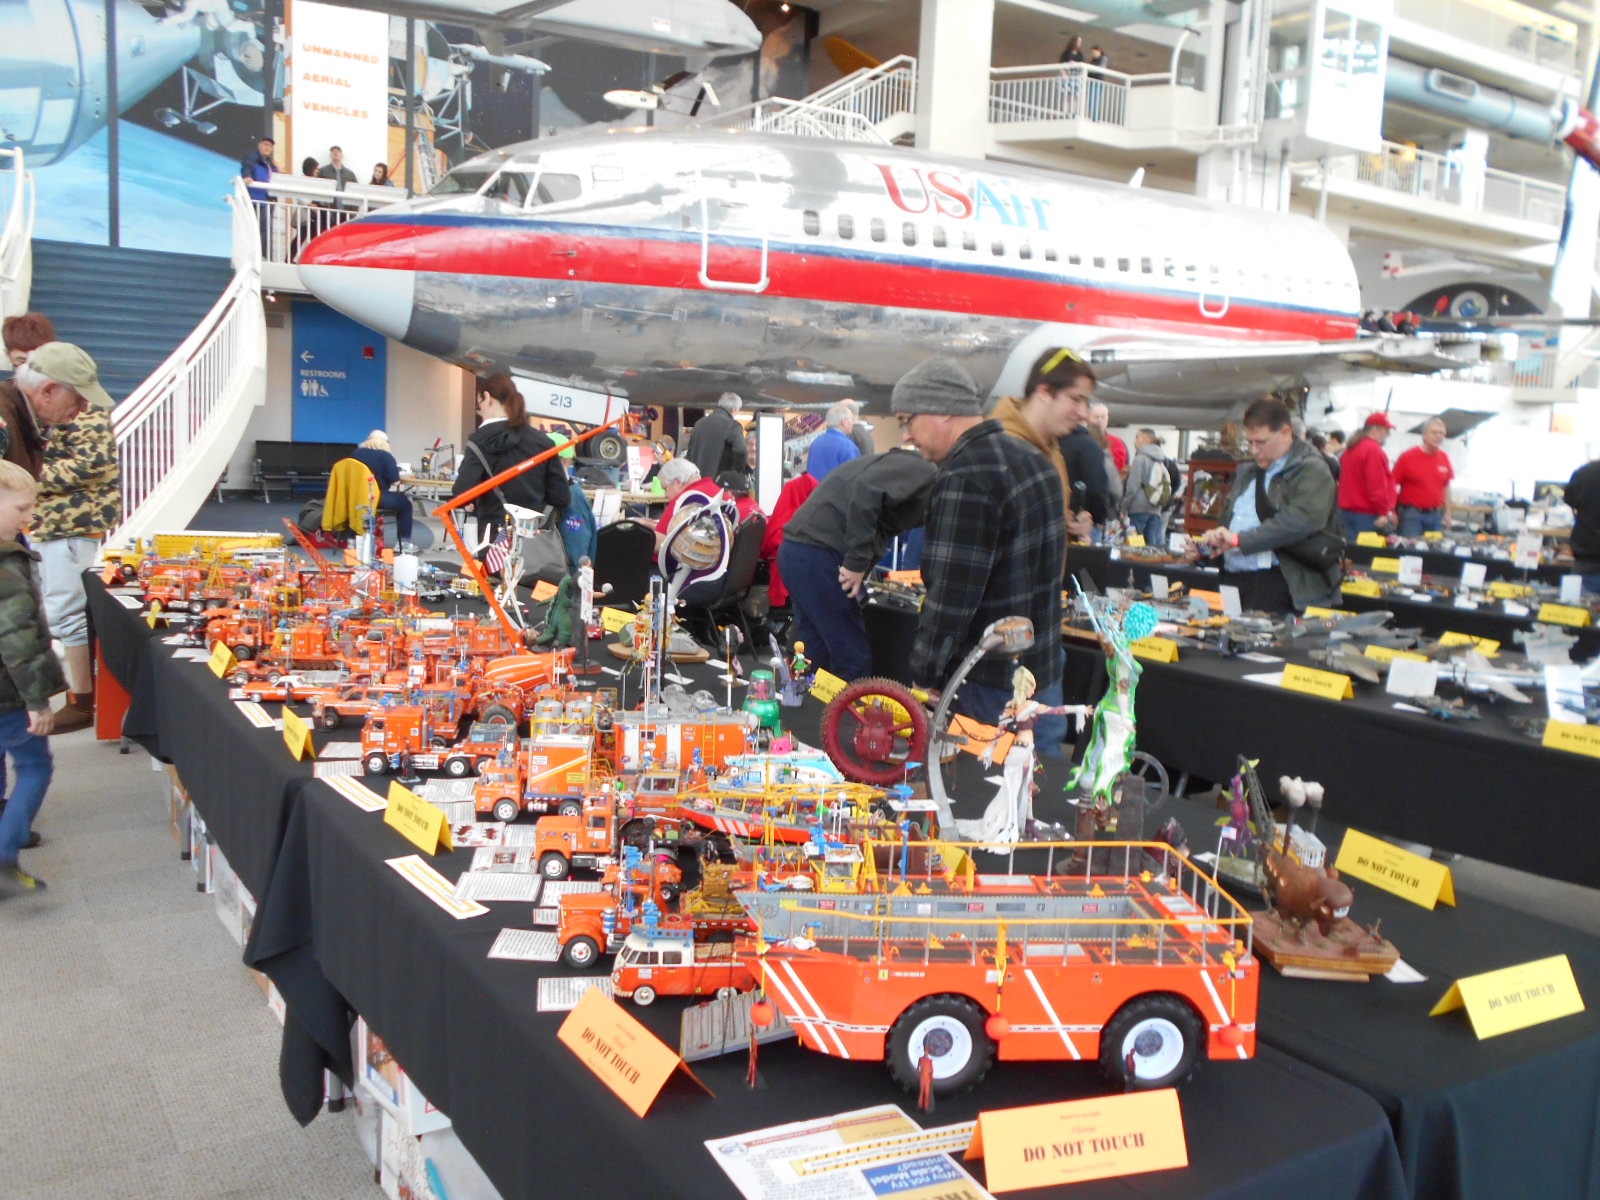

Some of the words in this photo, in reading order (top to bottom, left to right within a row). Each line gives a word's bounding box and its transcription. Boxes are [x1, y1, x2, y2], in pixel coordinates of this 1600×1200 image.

[302, 43, 380, 65] UNMANNED
[302, 72, 352, 88] AERIAL
[302, 101, 369, 119] VEHICLES
[300, 368, 347, 379] RESTROOMS
[549, 393, 572, 409] 213
[1357, 856, 1369, 867] DO
[1372, 861, 1387, 875] NOT
[1390, 870, 1420, 888] TOUCH
[1488, 997, 1502, 1010] DO
[1504, 992, 1522, 1006] NOT
[1524, 983, 1556, 1001] TOUCH
[581, 1026, 595, 1044] DO
[593, 1035, 613, 1059] NOT
[610, 1052, 641, 1085] TOUCH
[1023, 1146, 1046, 1163] DO
[1052, 1140, 1085, 1159] NOT
[1088, 1132, 1146, 1154] TOUCH
[869, 1171, 911, 1187] Model
[910, 1166, 944, 1178] Scale
[890, 1179, 909, 1190] try
[909, 1176, 931, 1186] not
